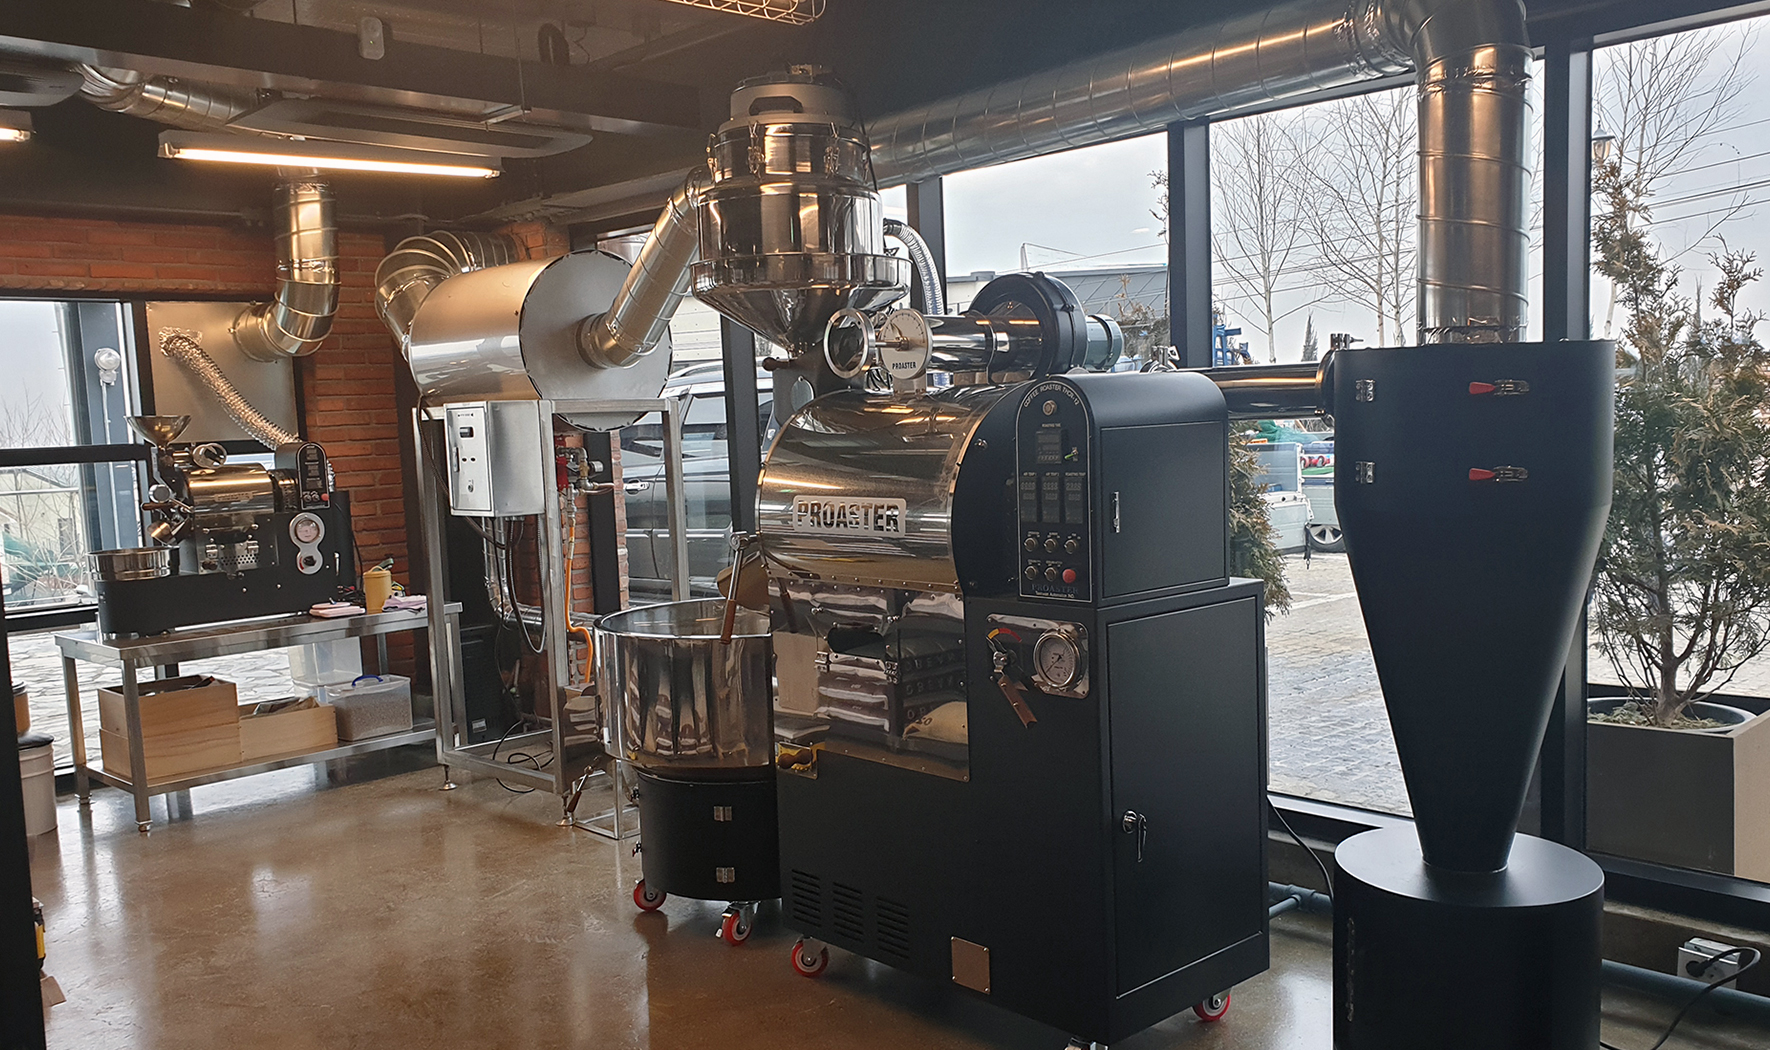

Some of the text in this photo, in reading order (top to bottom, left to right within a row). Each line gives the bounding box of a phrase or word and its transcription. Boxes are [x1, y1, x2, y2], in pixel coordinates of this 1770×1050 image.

[892, 361, 917, 370] PROASTER
[1023, 390, 1039, 407] COFFEE
[1040, 384, 1061, 393] ROASTER
[797, 500, 900, 533] PROASTER
[1031, 583, 1079, 594] PROASTER
